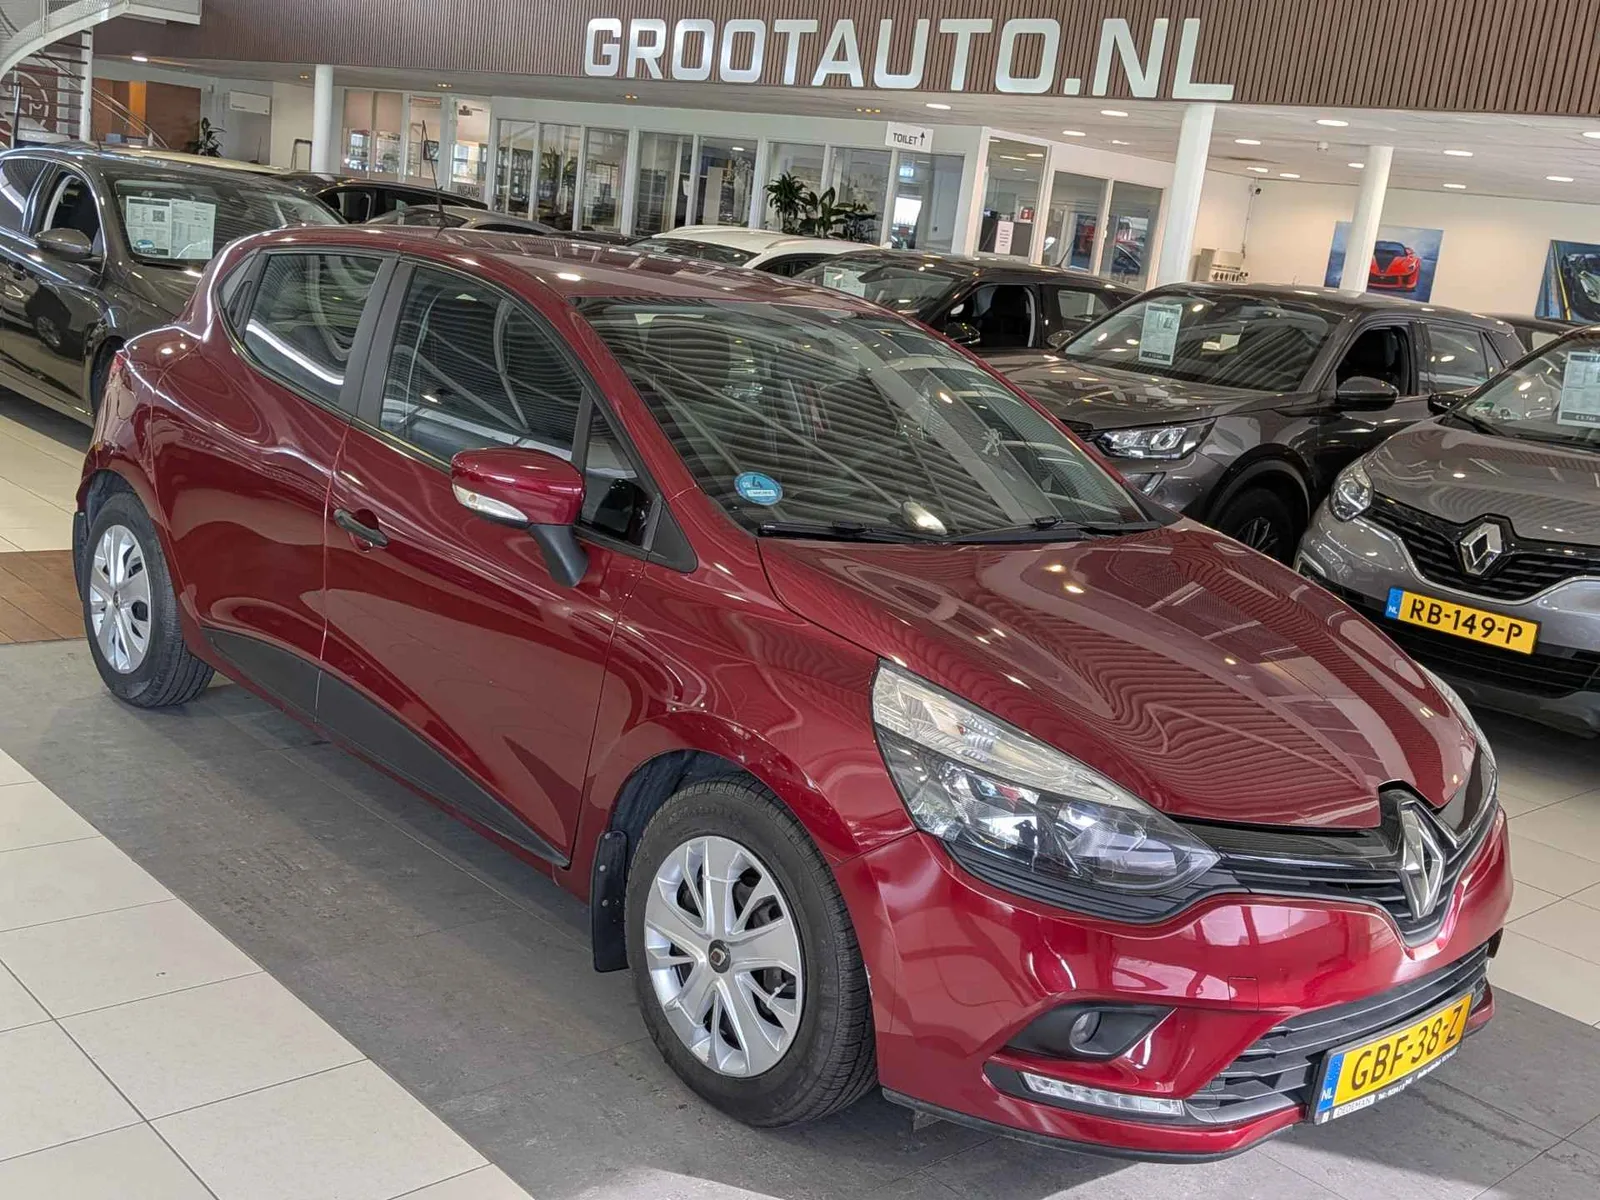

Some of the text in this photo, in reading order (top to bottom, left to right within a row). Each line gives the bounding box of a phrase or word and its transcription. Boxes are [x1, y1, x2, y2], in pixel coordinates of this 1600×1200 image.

[584, 17, 1235, 101] GROOTAUTO.NL
[893, 132, 918, 146] TOILET
[1388, 605, 1398, 614] NL
[1409, 598, 1523, 644] RB-149-P
[1351, 1005, 1464, 1091] GBF-38-Z
[1321, 1086, 1333, 1102] NL
